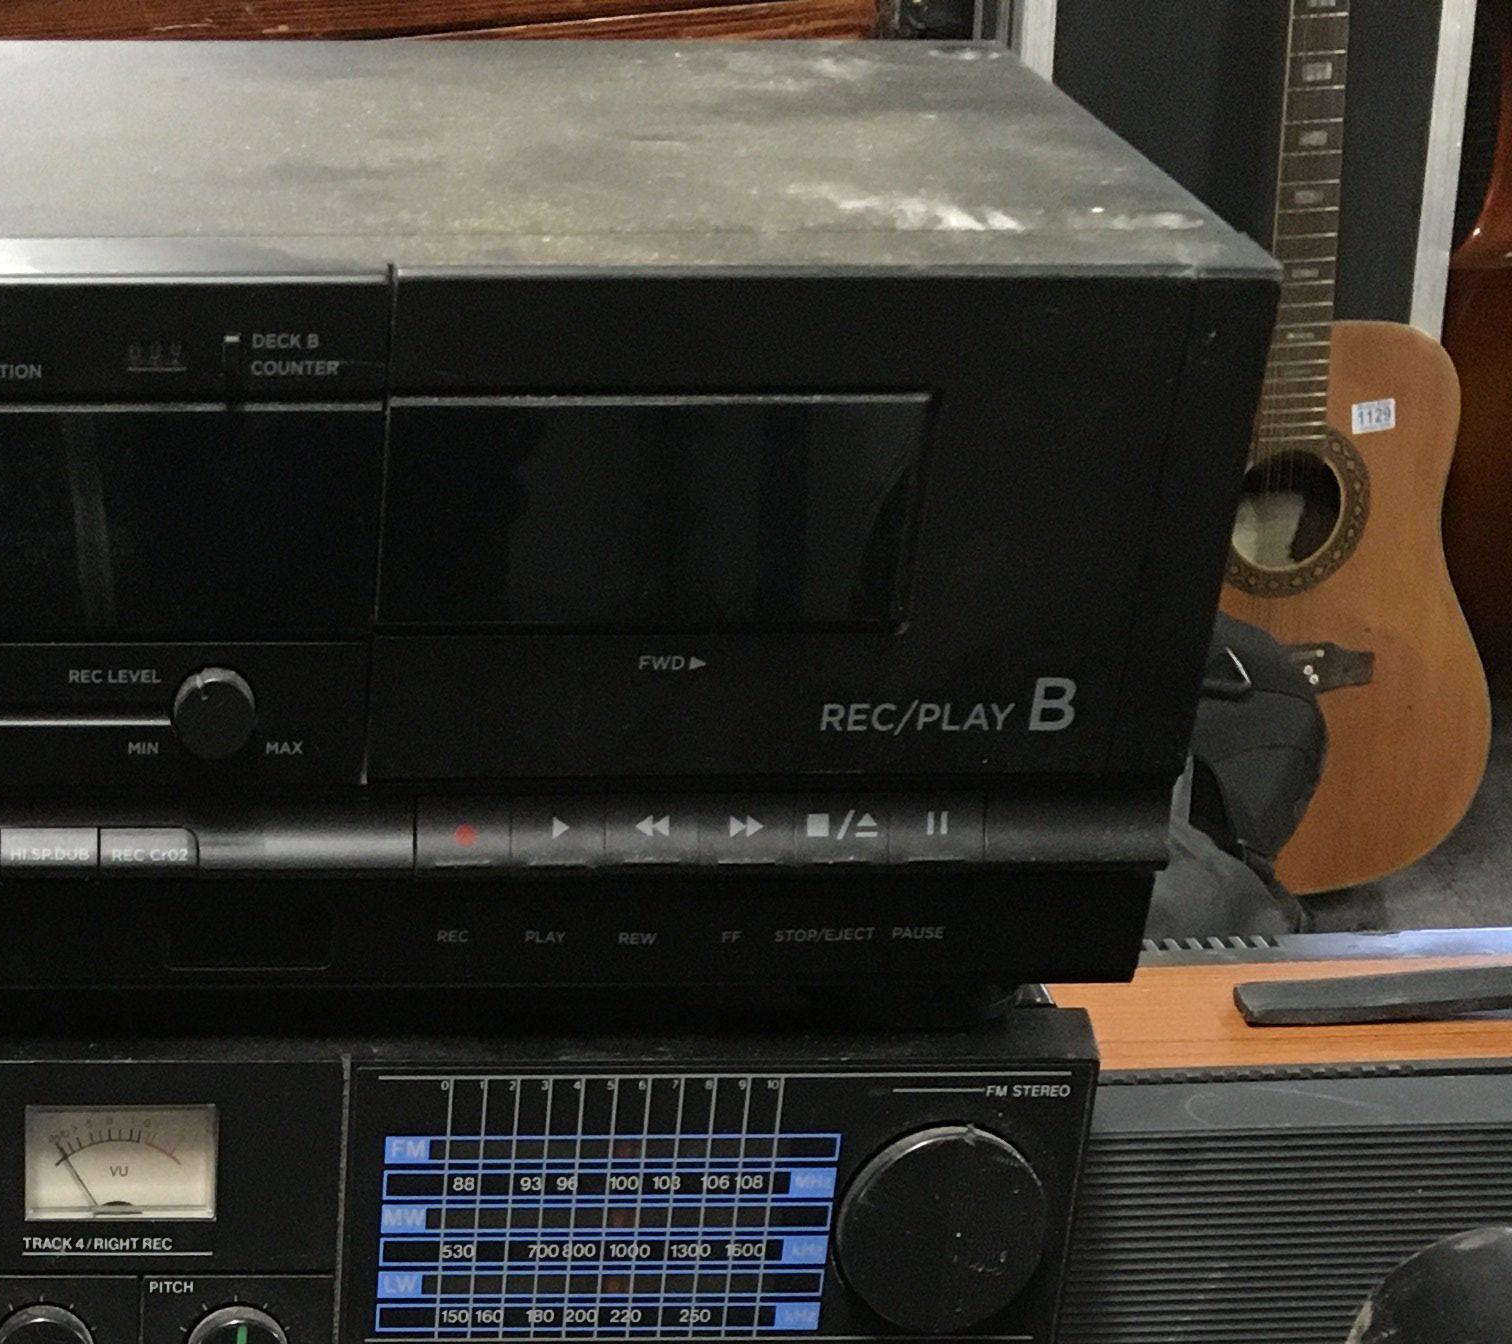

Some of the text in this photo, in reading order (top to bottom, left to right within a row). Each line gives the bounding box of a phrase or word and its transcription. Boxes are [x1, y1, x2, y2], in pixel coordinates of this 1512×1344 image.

[252, 333, 319, 348] DECK B
[251, 360, 340, 376] COUNTER
[639, 656, 685, 670] FWD
[69, 669, 161, 683] REC LEVEL
[820, 678, 1076, 735] REC/PLAY B
[128, 742, 158, 754] MIN
[266, 742, 302, 754] MAX
[437, 930, 469, 942] REC
[986, 1085, 1070, 1097] FM STEREO
[453, 1177, 474, 1191] 88
[520, 1177, 541, 1191] 93
[610, 1177, 638, 1191] 100
[701, 1177, 729, 1191] 106
[735, 1177, 763, 1191] 108
[23, 1237, 172, 1250] TRACK 4/RIGHT REC
[441, 1244, 765, 1258] 530 700 800 1000 1300 1600
[150, 1281, 193, 1293] PITCH
[441, 1309, 710, 1323] 150 160 180 200 220 250
